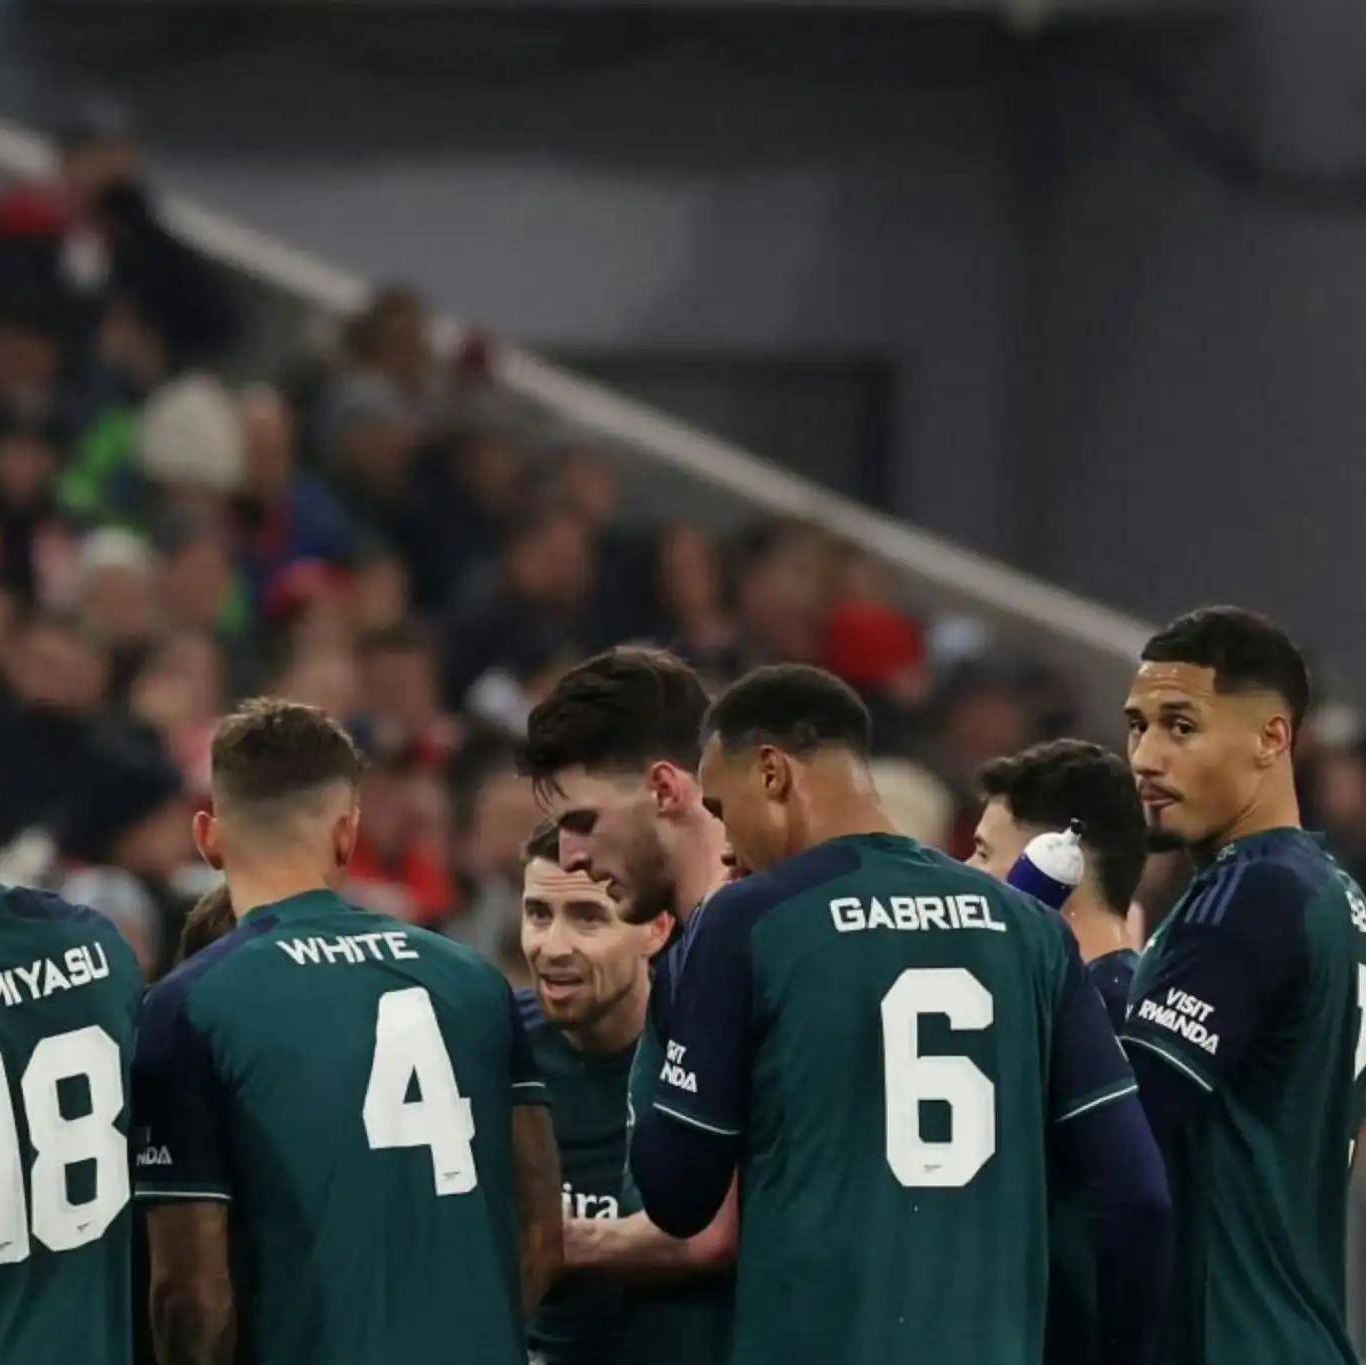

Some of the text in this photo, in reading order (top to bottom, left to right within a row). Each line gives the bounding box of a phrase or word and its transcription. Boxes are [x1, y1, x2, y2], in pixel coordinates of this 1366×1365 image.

[829, 894, 1007, 932] GABRIEL
[275, 931, 420, 966] WHITE
[1166, 986, 1215, 1022] VISIT
[1138, 998, 1221, 1055] RWANDA
[362, 986, 478, 1196] 4
[659, 1060, 698, 1093] NDA
[880, 967, 997, 1188] 6
